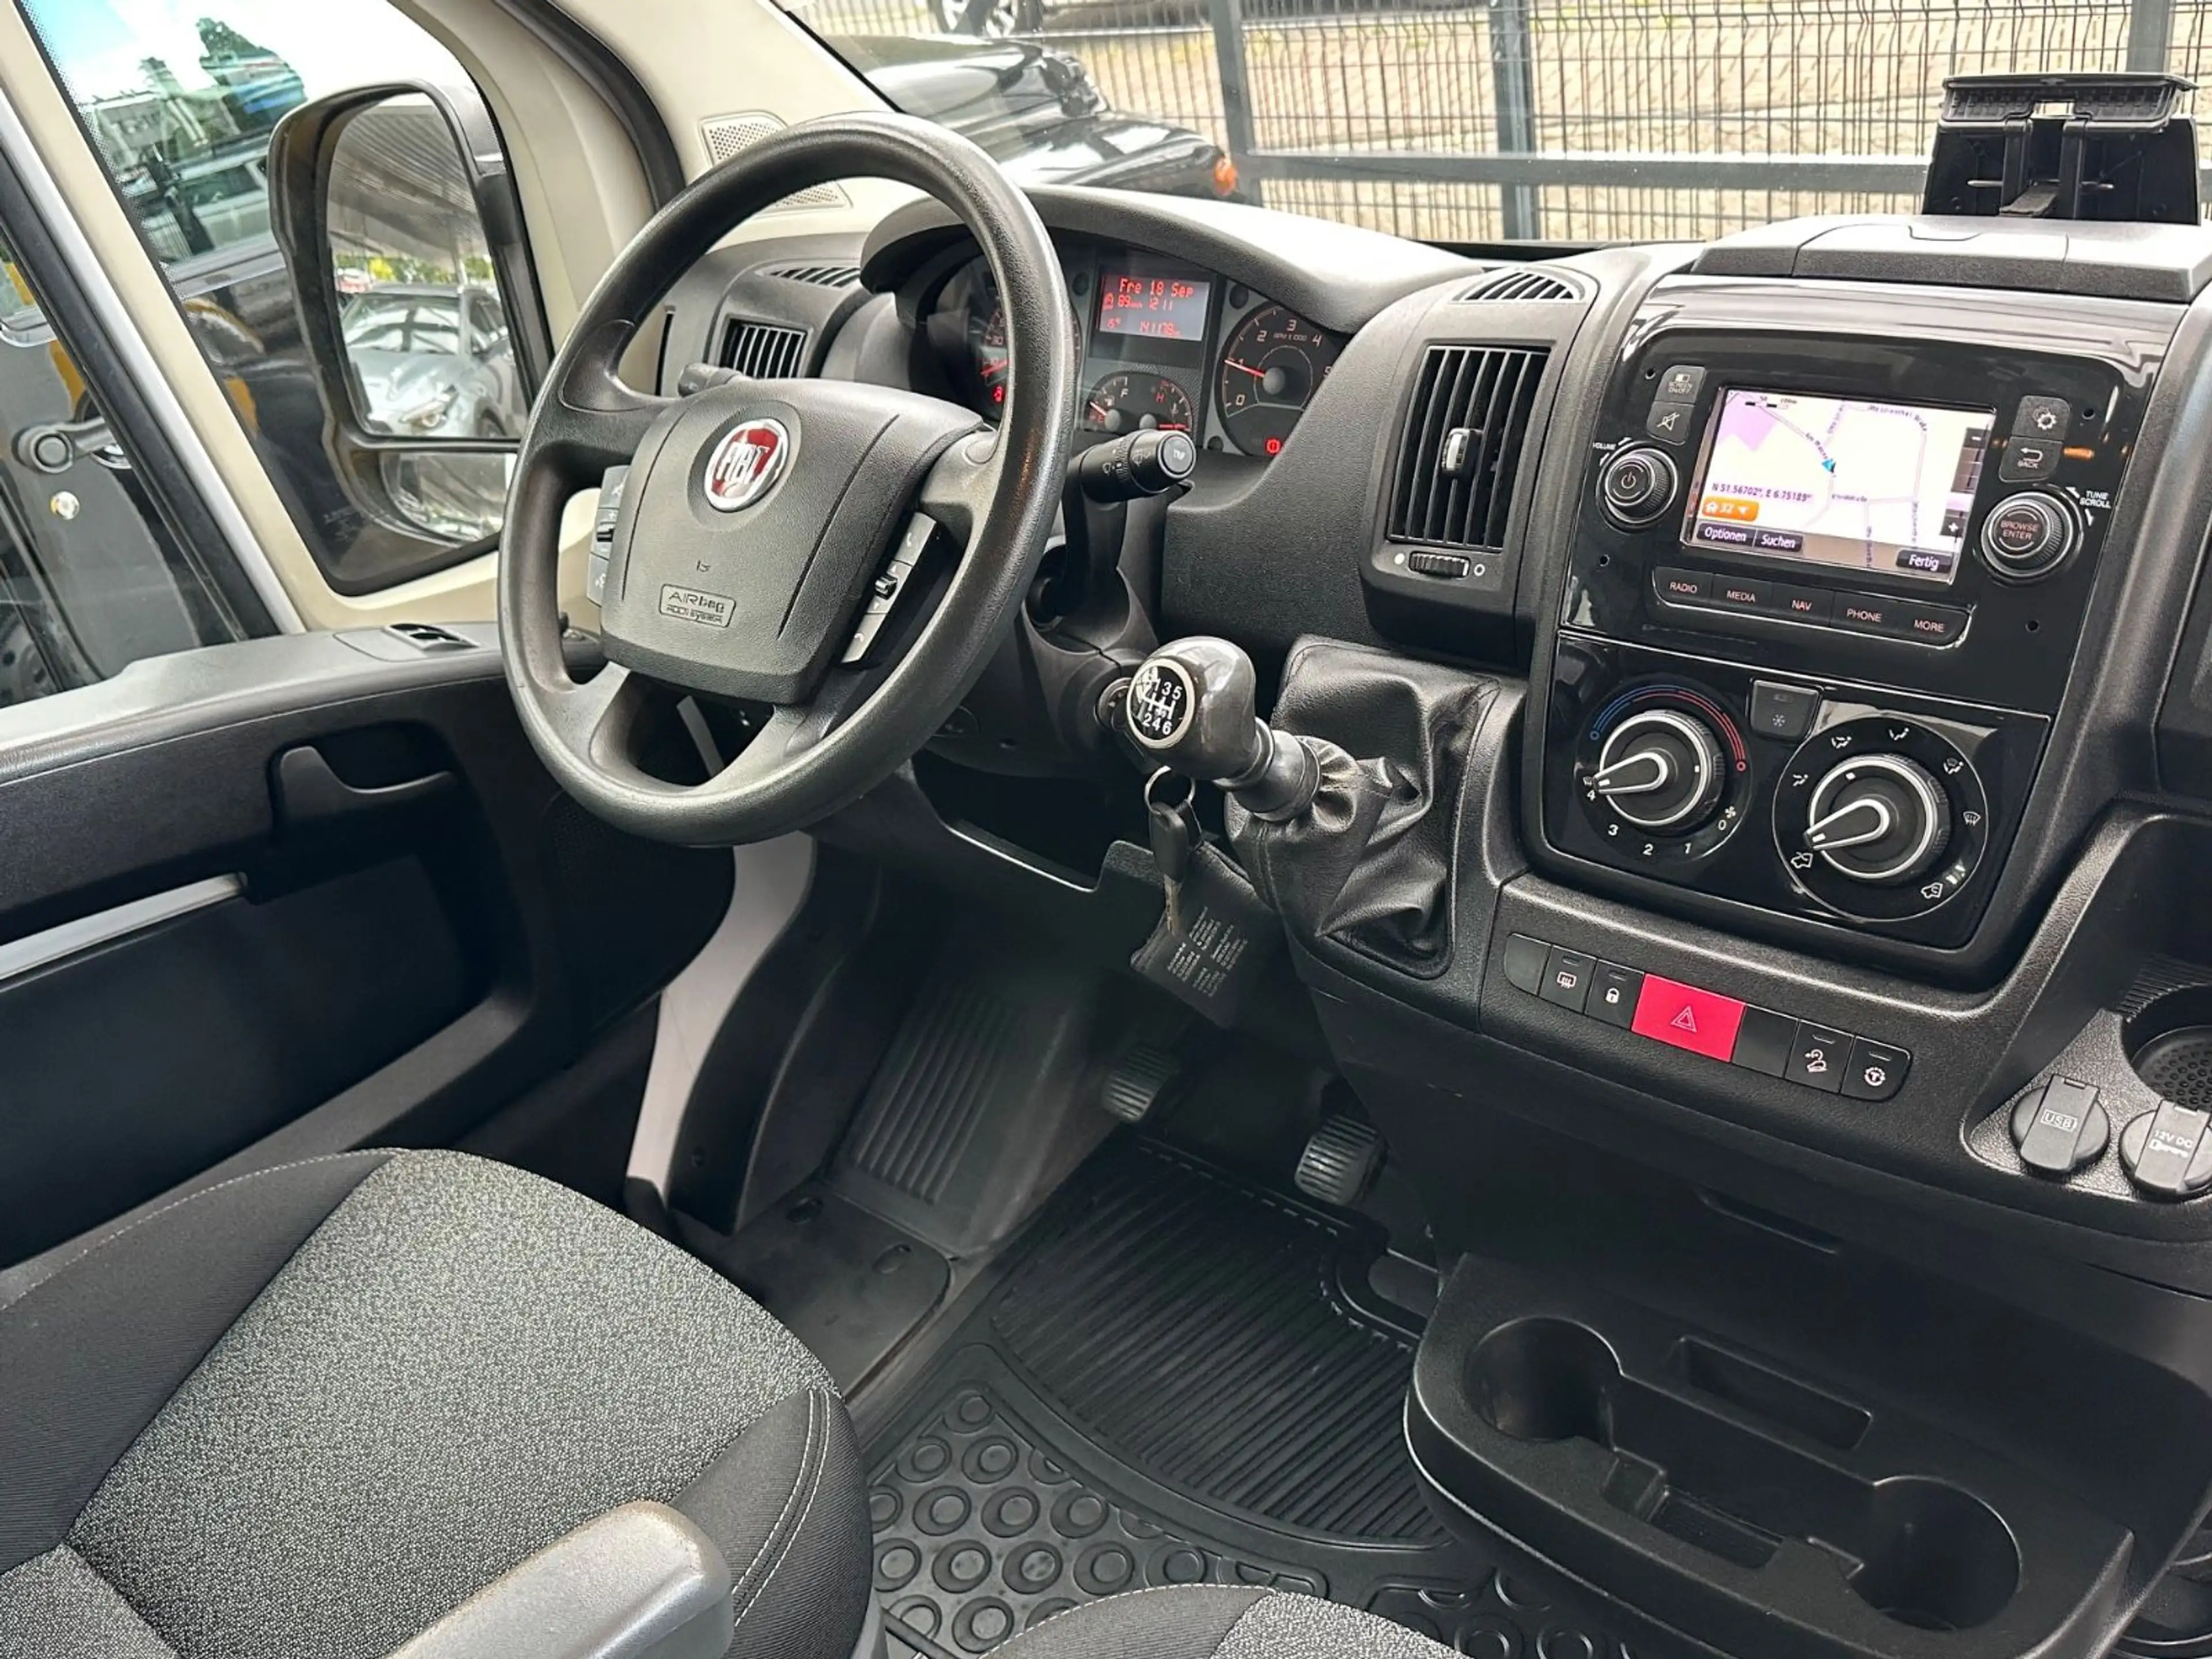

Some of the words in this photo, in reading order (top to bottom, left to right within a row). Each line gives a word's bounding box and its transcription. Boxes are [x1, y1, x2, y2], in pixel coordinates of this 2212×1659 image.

[1119, 276, 1142, 294] Fre
[1150, 279, 1164, 296] 18
[1171, 281, 1194, 298] Sep
[1287, 319, 1297, 331] 3
[1257, 330, 1267, 342] 2
[1312, 334, 1321, 347] 4
[1120, 388, 1129, 399] F
[1236, 395, 1245, 406] 0
[715, 441, 771, 484] FIAT
[1712, 483, 1719, 491] N
[1766, 490, 1771, 498] E
[2086, 490, 2108, 500] TUNE
[2080, 497, 2111, 509] SCROLL
[2001, 520, 2039, 532] BROWSE
[1705, 527, 1747, 542] Optionen
[1761, 534, 1796, 548] Suchen
[2002, 529, 2032, 540] ENTER
[1908, 554, 1940, 571] Fertig
[1669, 581, 1698, 594] RADIO
[1726, 590, 1756, 603] MEDIA
[1791, 599, 1812, 611] NAV
[1846, 608, 1882, 623] PHONE
[1914, 619, 1945, 633] MORE
[1161, 681, 1172, 695] 3
[1172, 685, 1183, 700] 5
[1142, 713, 1152, 728] 2
[1152, 718, 1161, 731] 4
[1162, 721, 1172, 735] 6
[1587, 790, 1596, 801] 4
[1608, 824, 1619, 836] 3
[1718, 819, 1727, 831] 0
[1642, 843, 1654, 856] 2
[1684, 842, 1692, 855] 1
[2044, 1112, 2072, 1127] USB
[2176, 1137, 2194, 1149] DC
